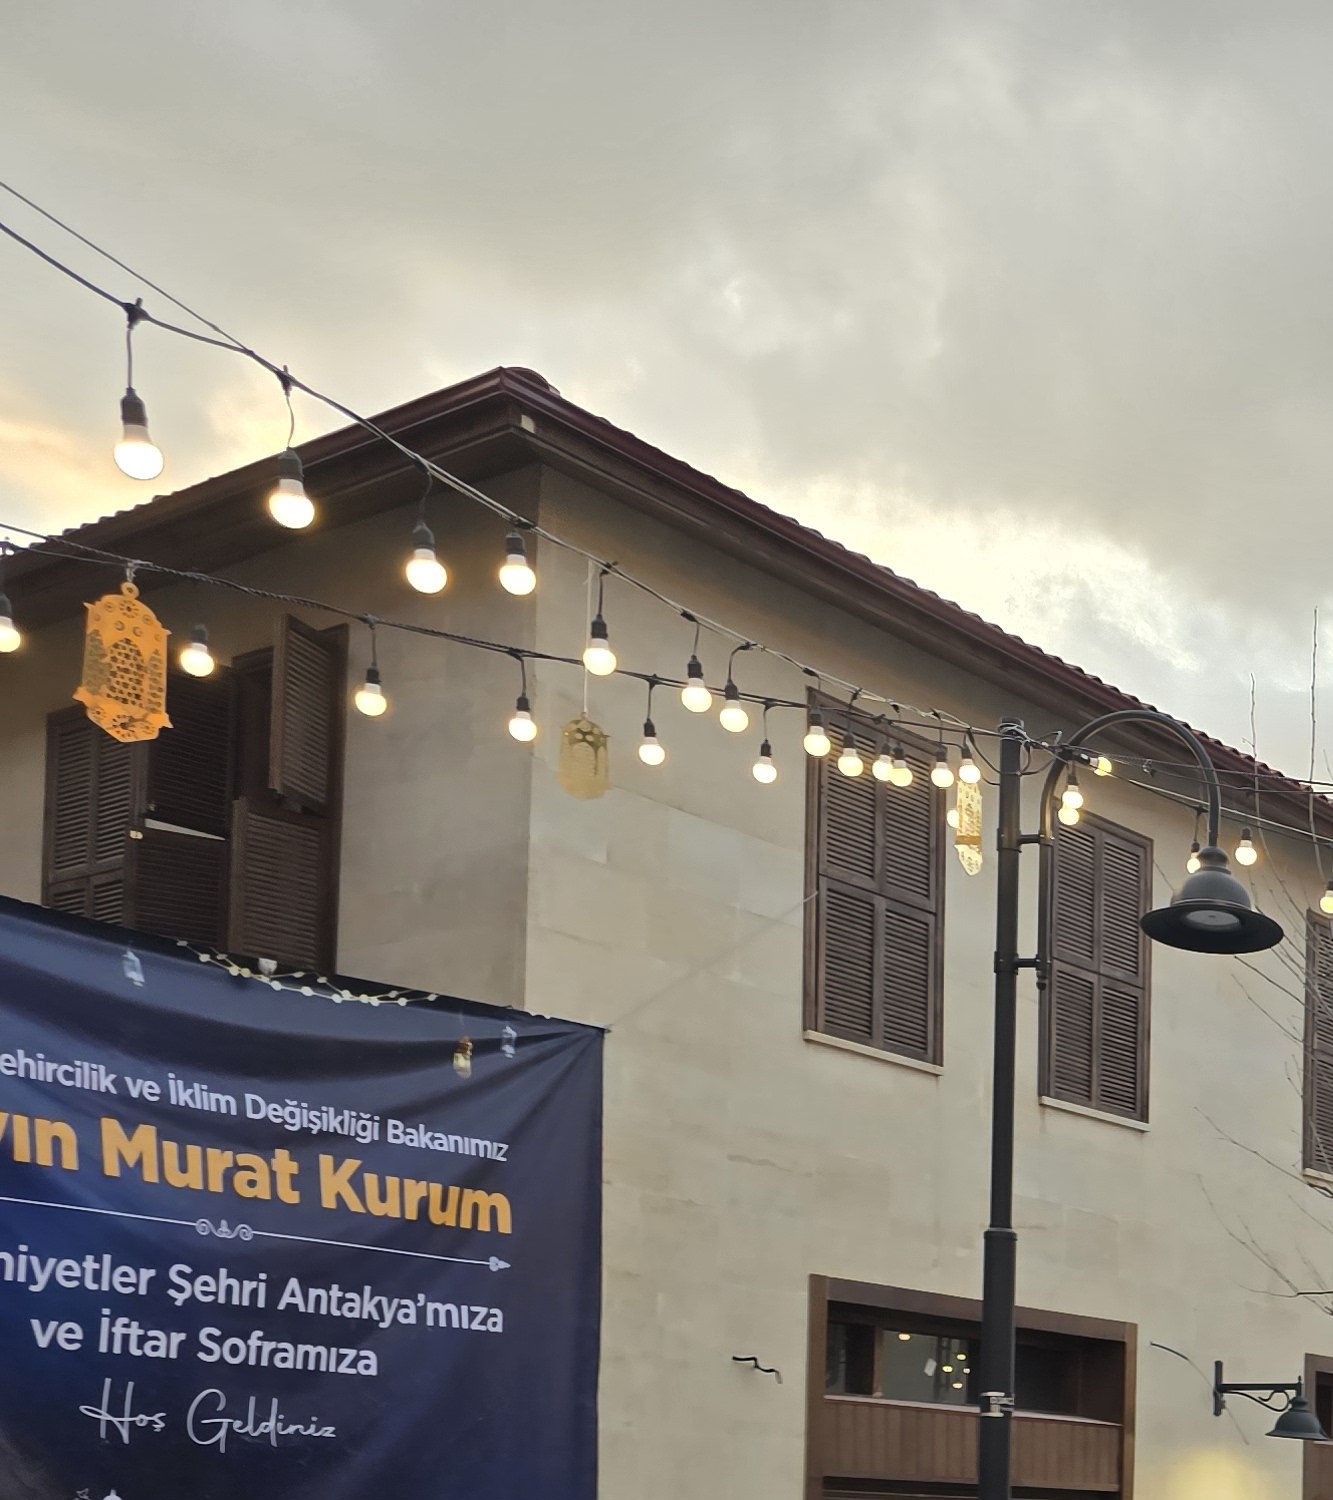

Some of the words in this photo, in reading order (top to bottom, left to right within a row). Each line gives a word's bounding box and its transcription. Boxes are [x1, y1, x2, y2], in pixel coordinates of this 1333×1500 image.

[0, 1049, 117, 1095] ehircilik
[125, 1076, 161, 1102] ve
[167, 1072, 237, 1116] İklim
[244, 1093, 380, 1144] Değişikliği
[387, 1119, 509, 1162] Bakanımız
[101, 1117, 300, 1204] Murat
[318, 1153, 512, 1234] Kurum
[167, 1263, 267, 1308] Şehri
[30, 1318, 84, 1351] ve
[98, 1308, 186, 1359] İftar
[197, 1326, 378, 1376] Soframıza
[79, 1377, 167, 1444] Hoş
[186, 1388, 337, 1453] Geldiniz
